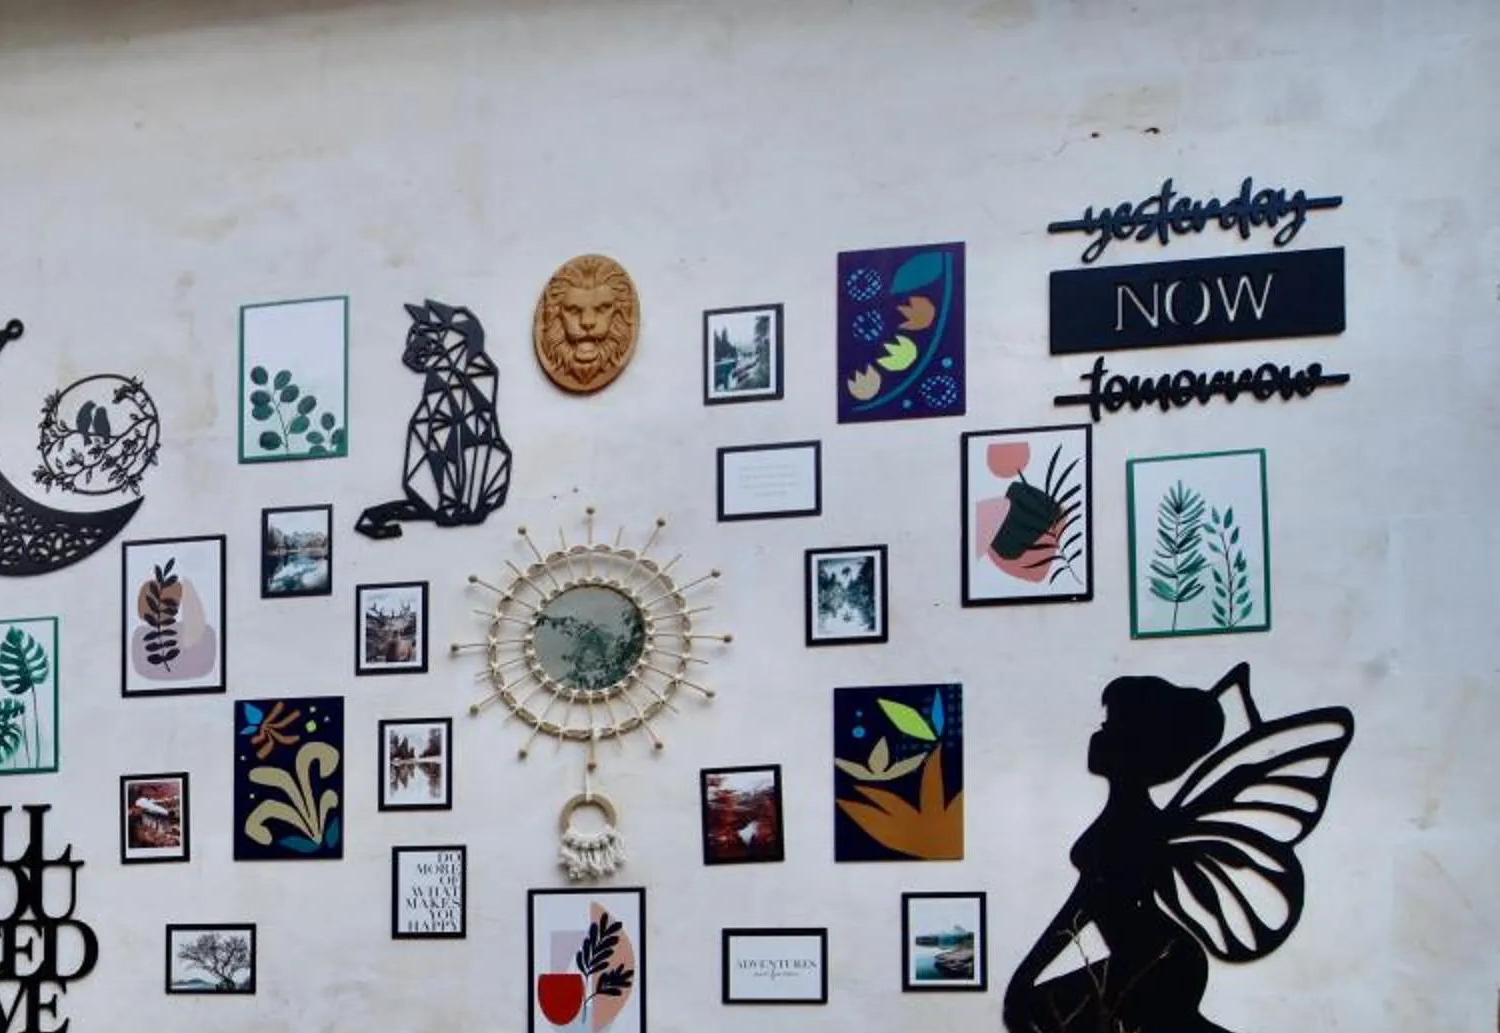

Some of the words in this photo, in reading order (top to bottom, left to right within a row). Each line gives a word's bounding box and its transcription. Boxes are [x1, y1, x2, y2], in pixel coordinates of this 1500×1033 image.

[1115, 273, 1273, 331] NOW
[417, 863, 461, 874] MORE
[411, 886, 461, 897] WHAT
[405, 897, 461, 909] MAKES
[407, 920, 458, 931] HAPPY
